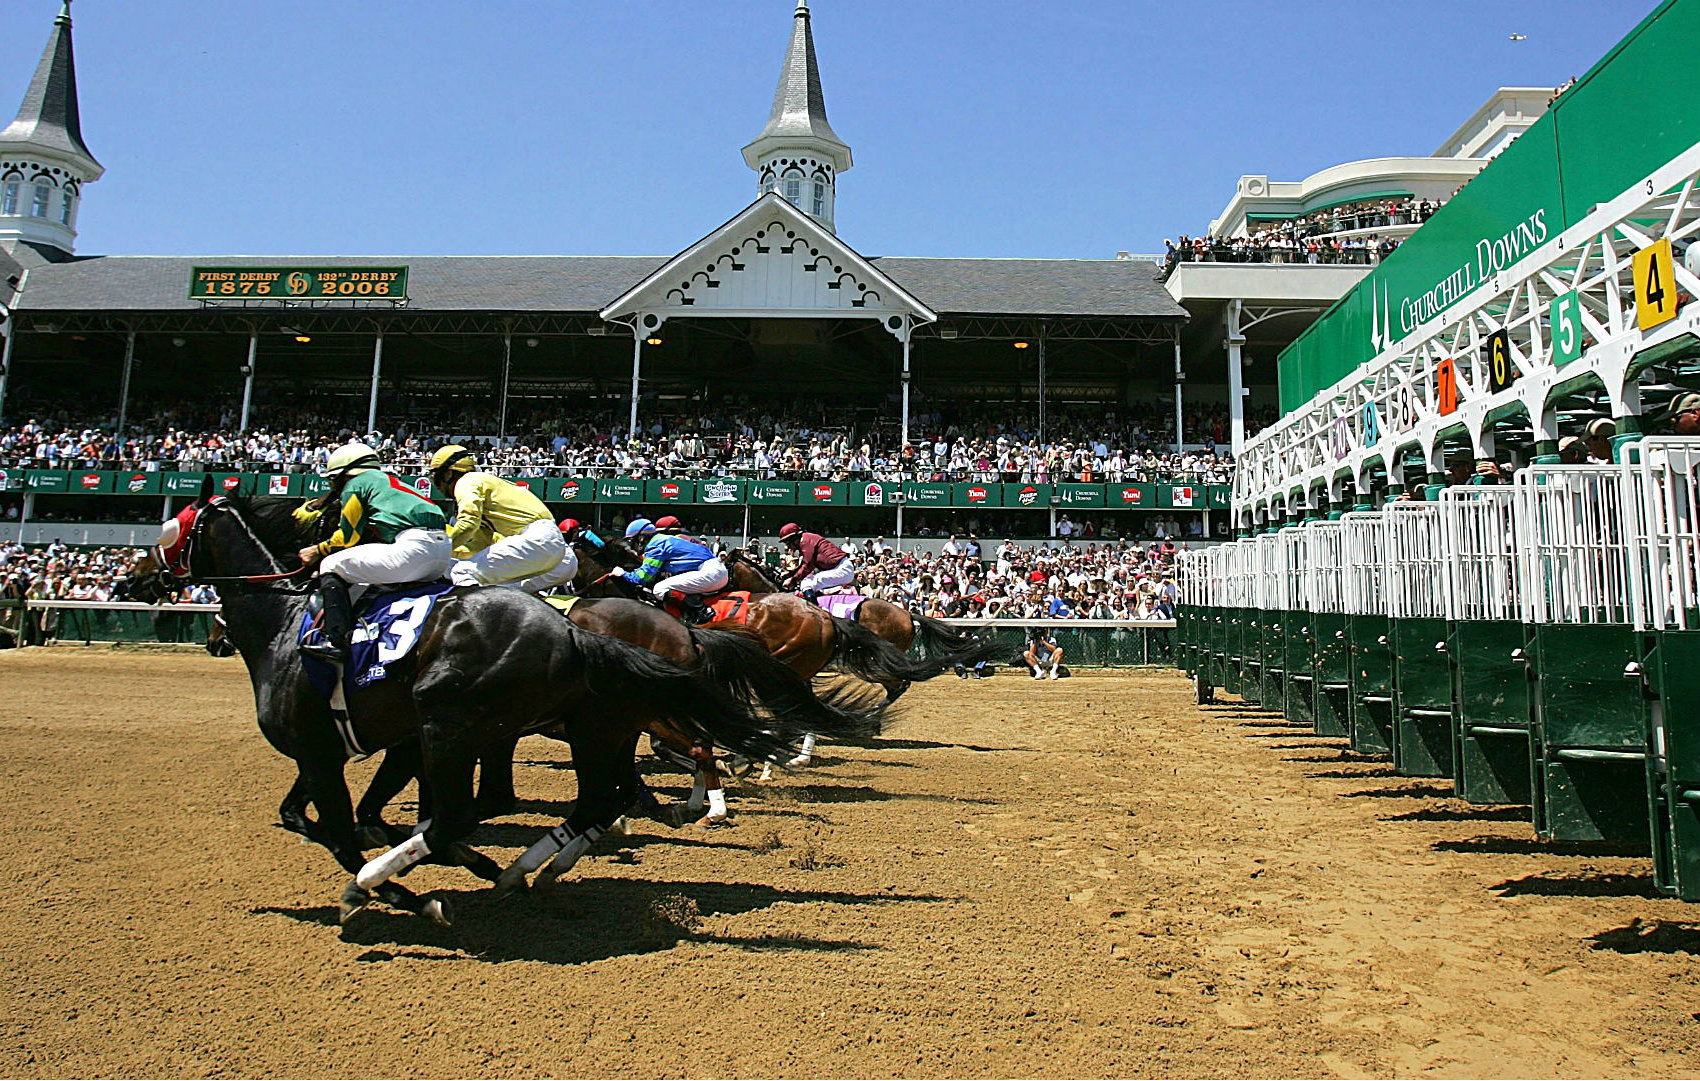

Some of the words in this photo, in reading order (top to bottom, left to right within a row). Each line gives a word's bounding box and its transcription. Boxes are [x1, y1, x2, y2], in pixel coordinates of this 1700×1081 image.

[1646, 180, 1654, 195] 3
[1558, 238, 1564, 250] 4
[199, 272, 236, 281] FIRST
[238, 272, 280, 281] DERBY
[351, 272, 398, 281] DERBY
[1400, 262, 1476, 332] CHURCHILL
[1476, 208, 1548, 283] DOWNS
[205, 282, 271, 294] 1875
[322, 282, 389, 294] 2006
[1494, 280, 1498, 292] 5
[1646, 252, 1665, 314] 4
[1442, 314, 1446, 325] 6
[1557, 299, 1574, 355] 5
[1493, 336, 1506, 386] 6
[1441, 365, 1450, 407] 7
[1401, 387, 1409, 426] 8
[1366, 406, 1372, 442] 9
[1338, 420, 1346, 454] 10
[662, 486, 679, 494] Yum!
[378, 595, 431, 662] 3
